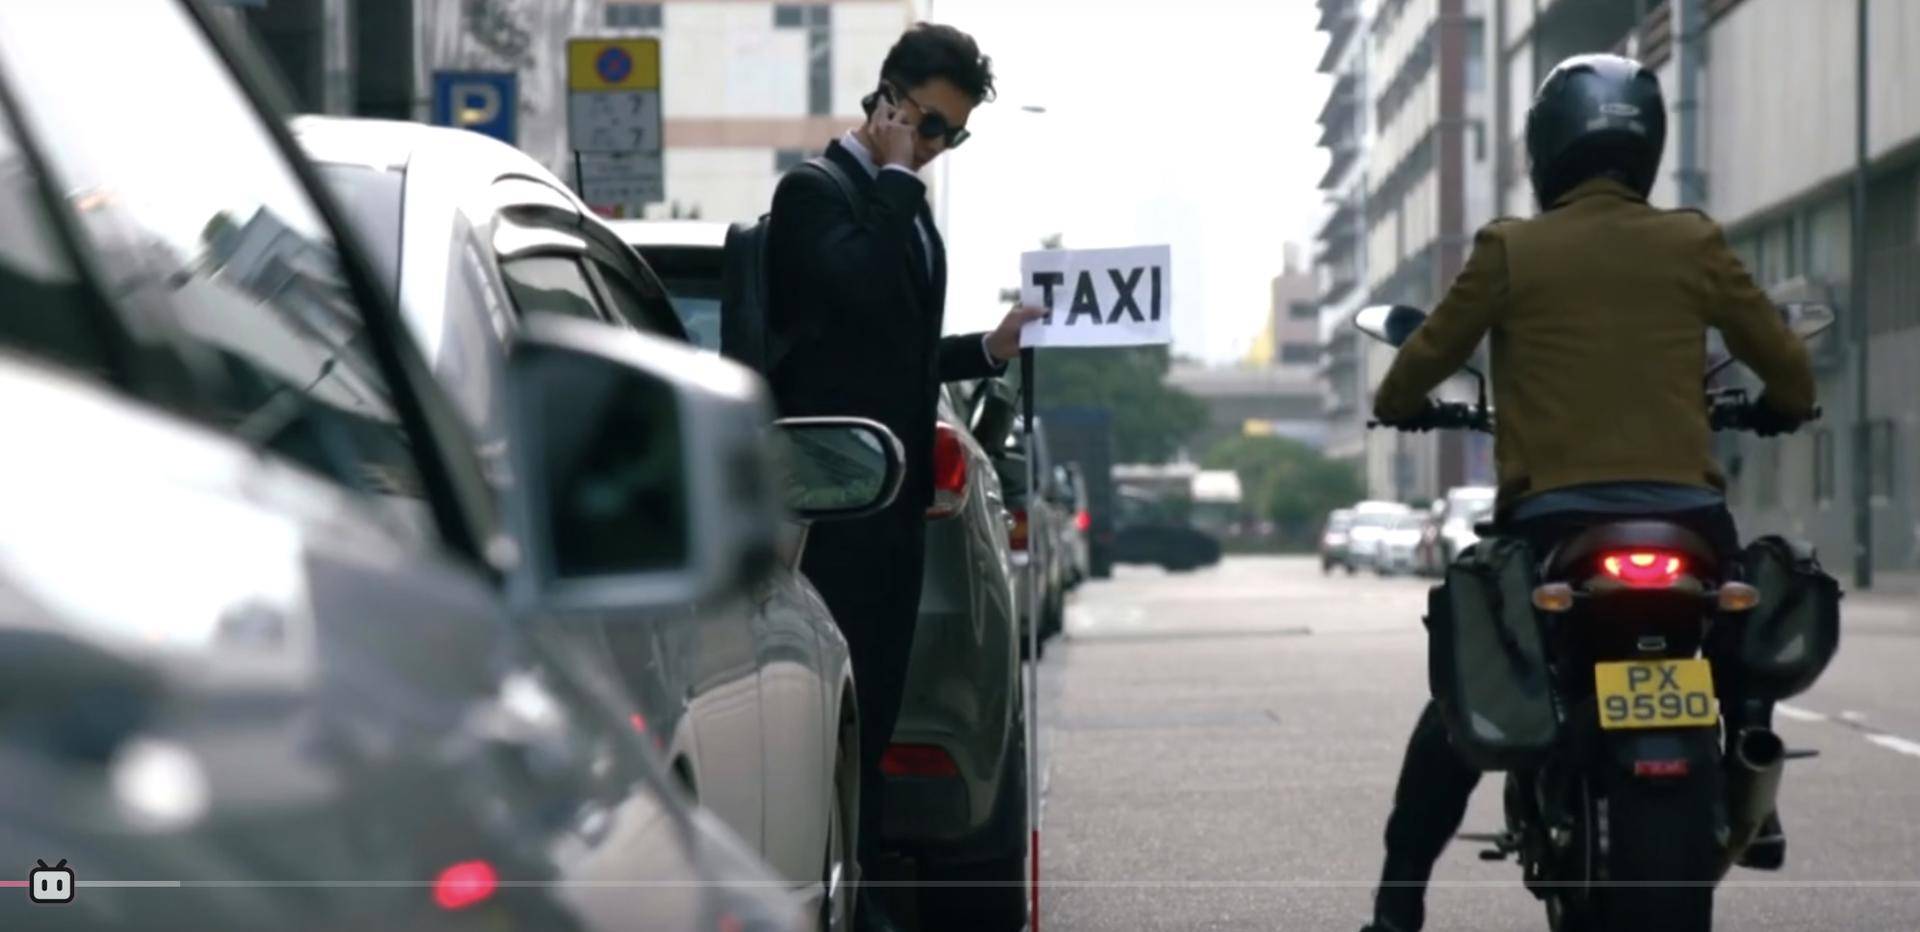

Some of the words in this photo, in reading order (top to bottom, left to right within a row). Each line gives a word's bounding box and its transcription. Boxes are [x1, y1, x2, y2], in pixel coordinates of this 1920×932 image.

[451, 83, 501, 128] P
[1032, 266, 1161, 325] TAXI
[1627, 665, 1680, 691] PX
[1605, 692, 1709, 721] 9590
